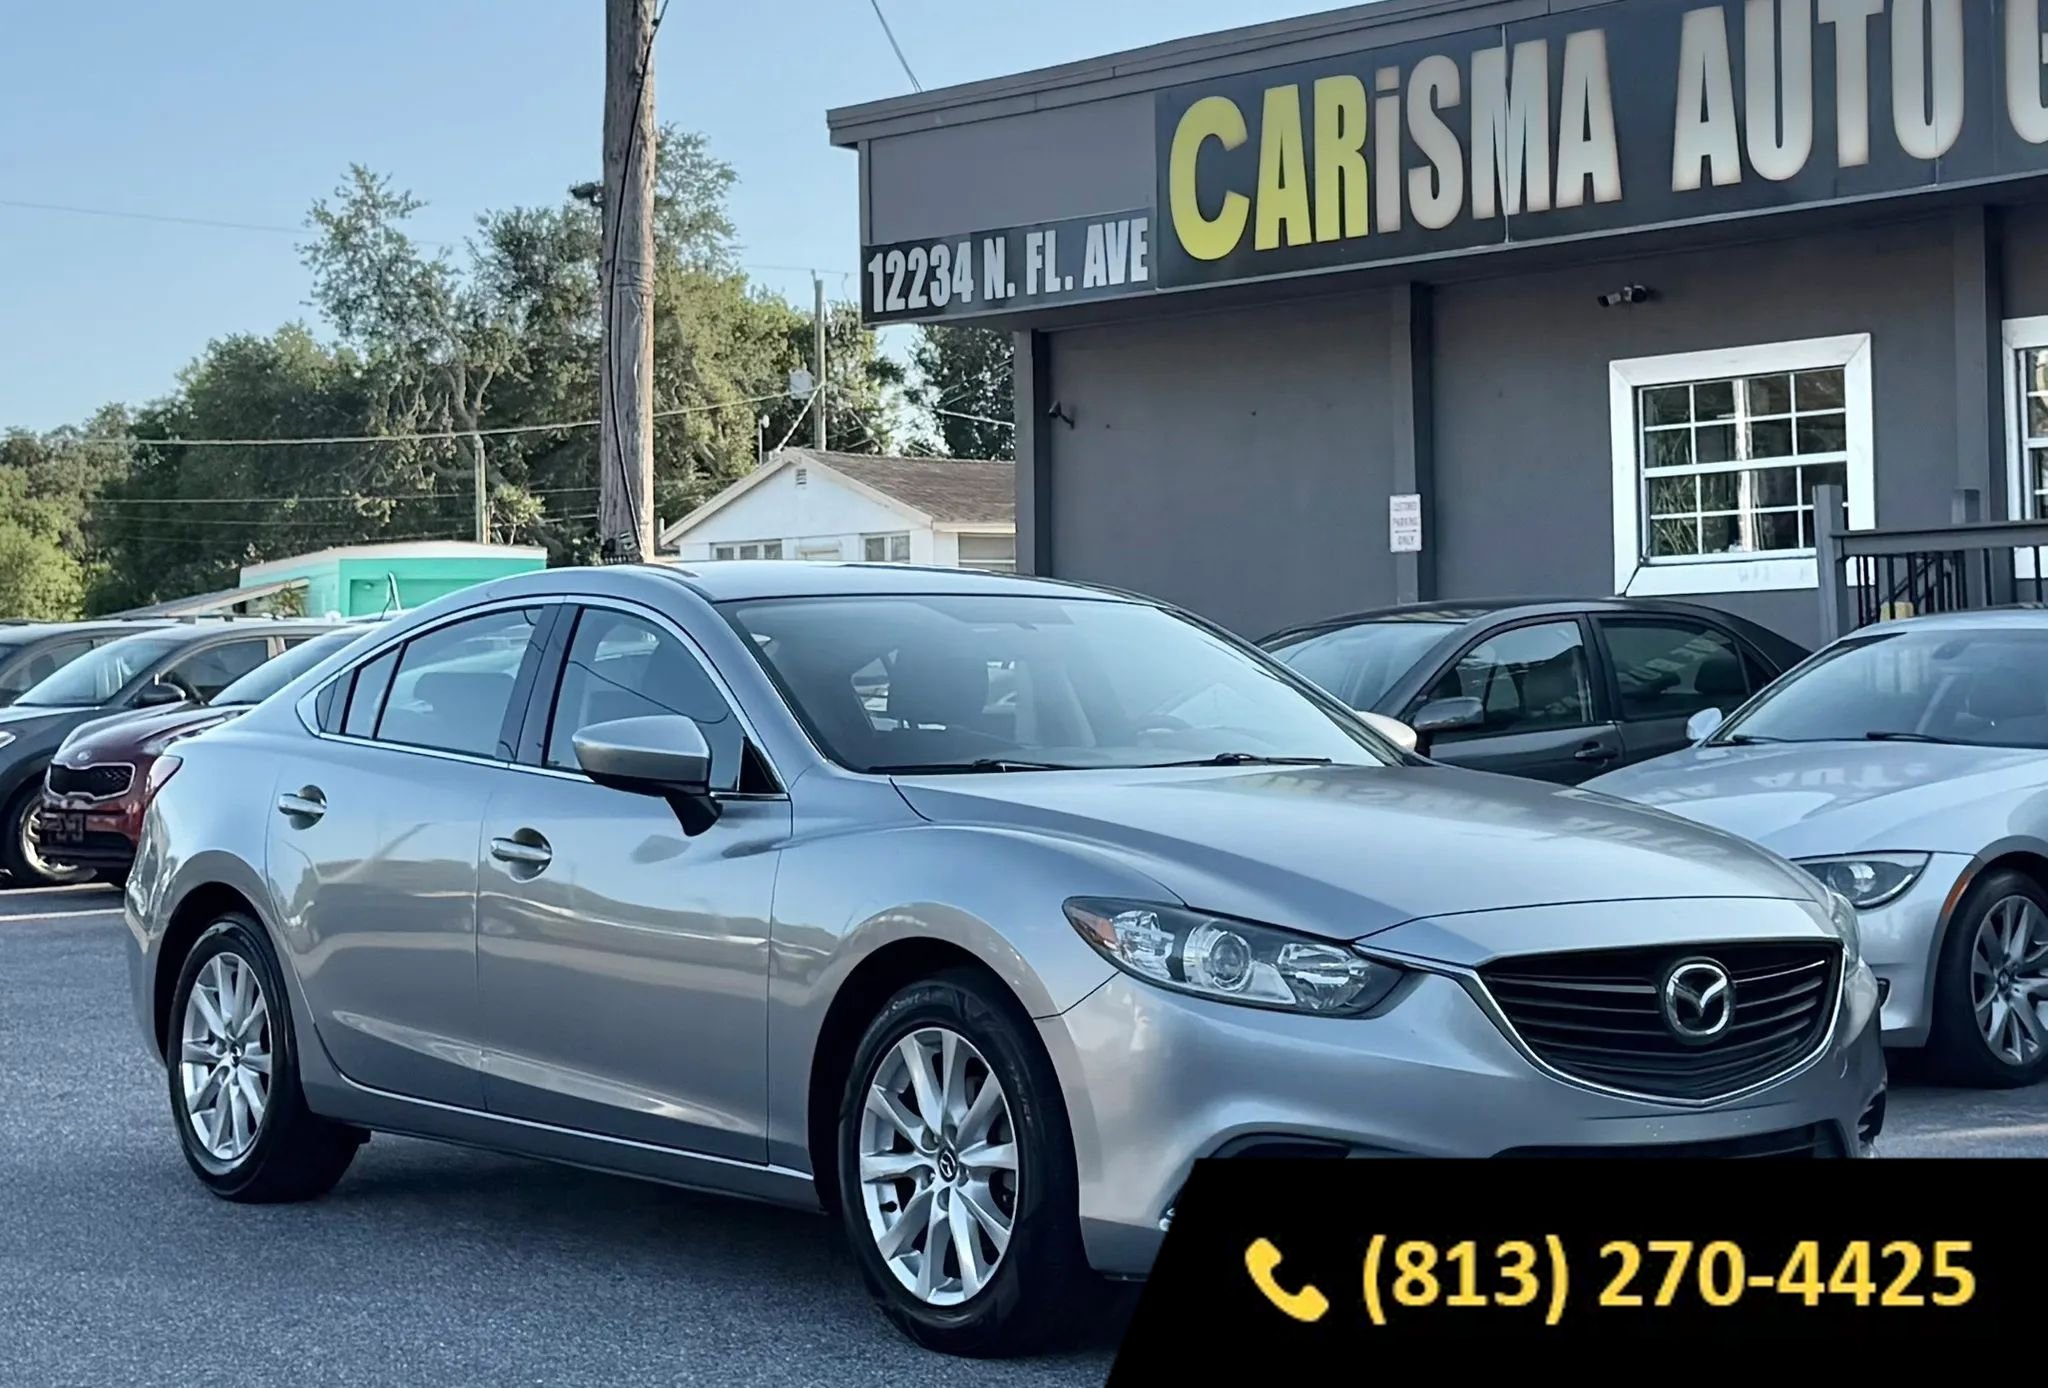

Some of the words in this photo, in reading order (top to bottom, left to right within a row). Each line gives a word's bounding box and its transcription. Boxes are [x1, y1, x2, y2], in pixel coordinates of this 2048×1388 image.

[1672, 0, 1965, 192] AUTO
[868, 241, 974, 313] 12234
[983, 236, 1016, 300] N.
[1026, 230, 1073, 295] FL.
[1083, 217, 1149, 289] AVE
